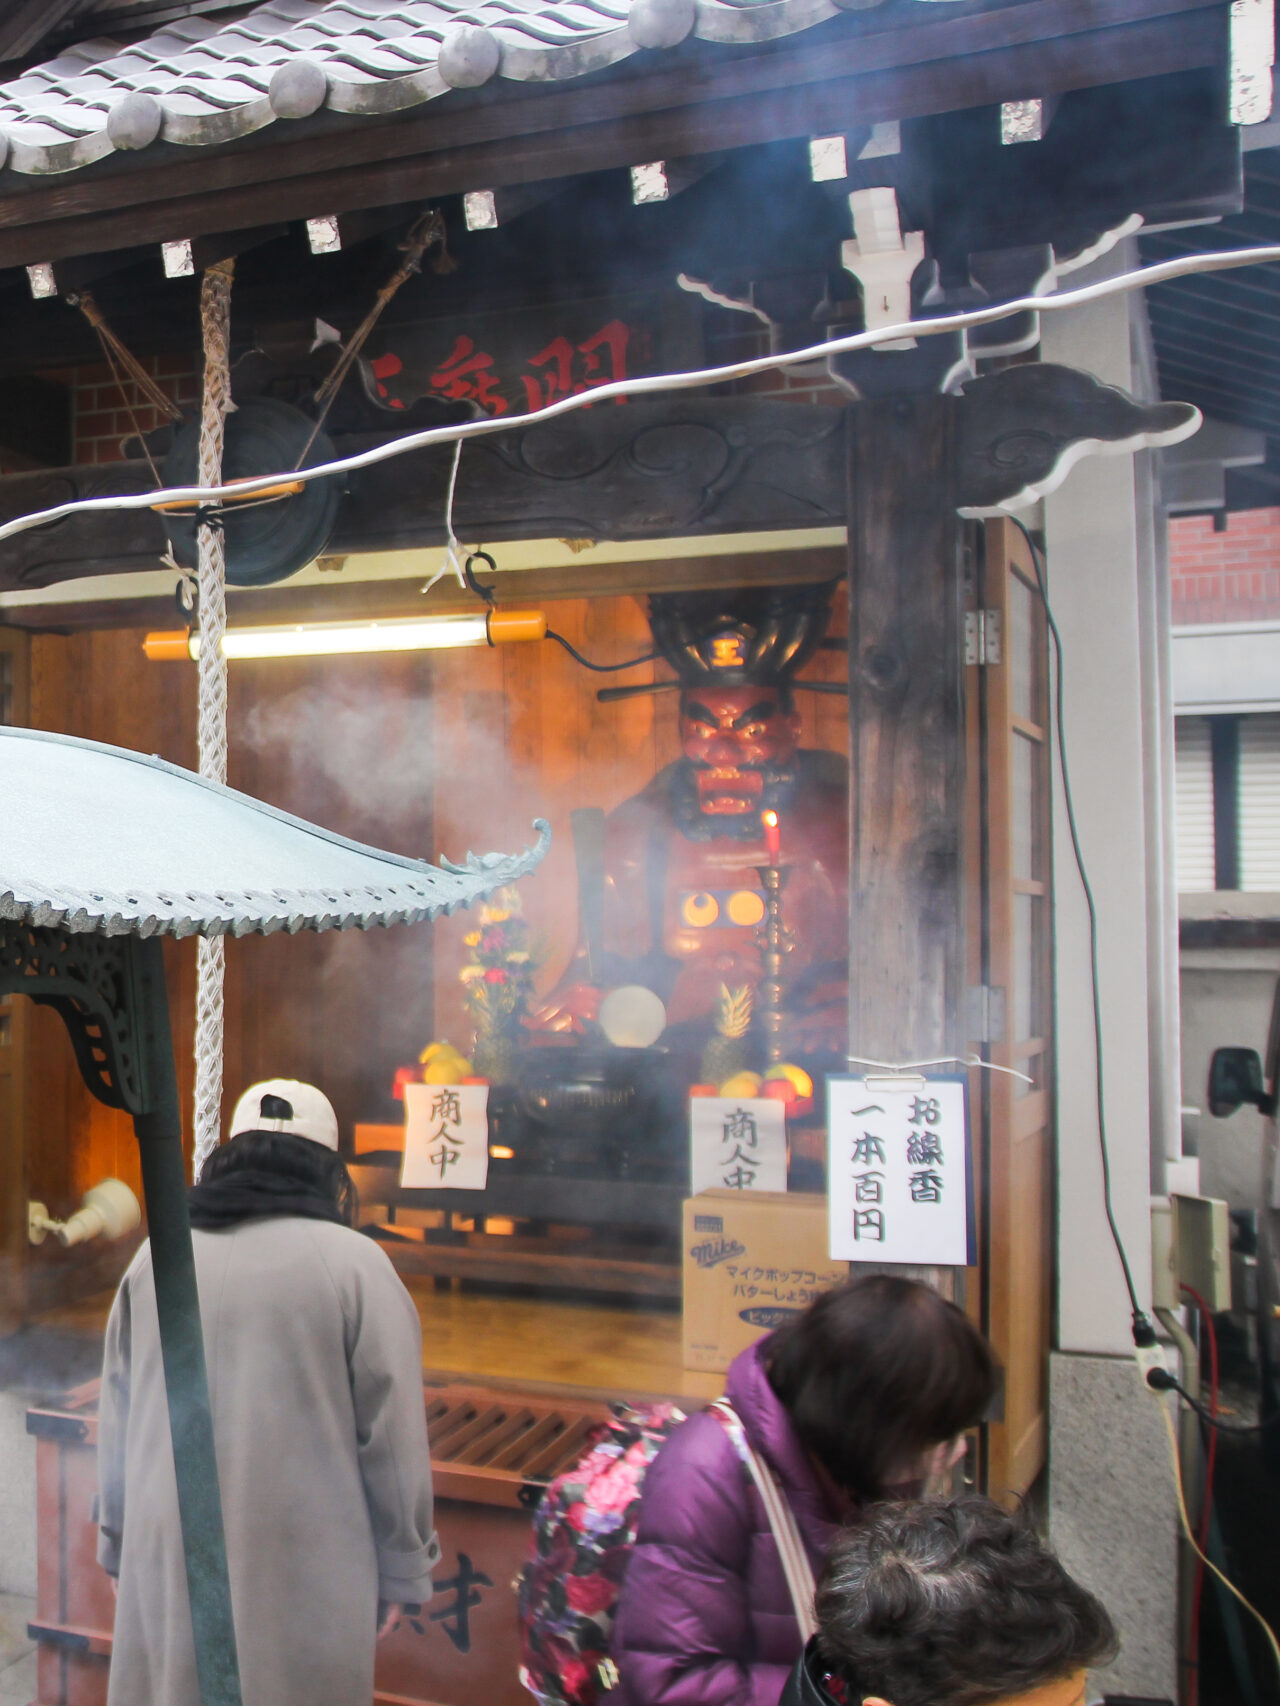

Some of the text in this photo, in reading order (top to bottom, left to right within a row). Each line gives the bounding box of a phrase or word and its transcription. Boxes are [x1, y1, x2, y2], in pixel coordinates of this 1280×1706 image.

[712, 638, 744, 667] 王
[429, 1089, 464, 1179] 商人中
[721, 1107, 761, 1190] 商人中
[851, 1104, 886, 1242] 一本百円
[907, 1096, 944, 1204] お線香
